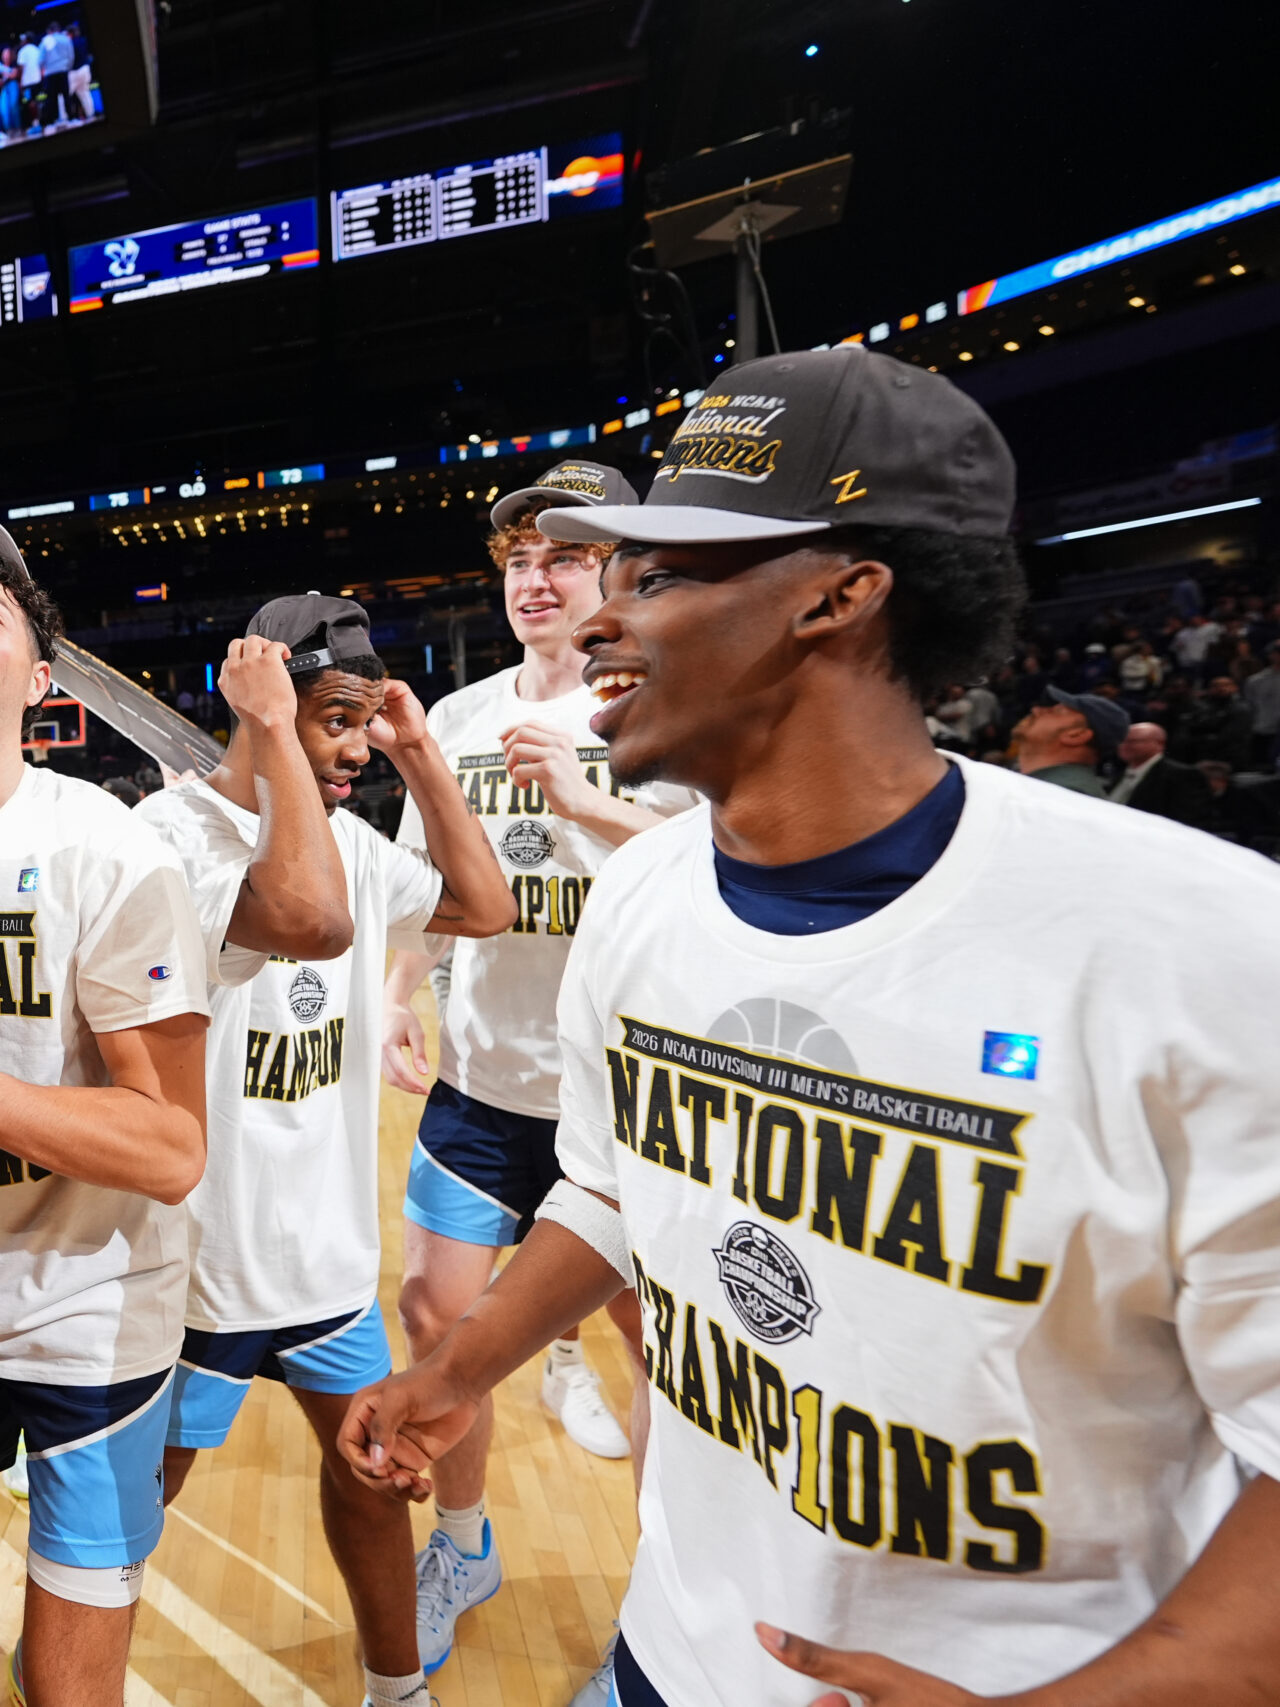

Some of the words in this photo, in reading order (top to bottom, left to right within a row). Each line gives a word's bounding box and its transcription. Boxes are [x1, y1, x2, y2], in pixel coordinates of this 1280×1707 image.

[631, 1027, 658, 1052] 2026
[662, 1038, 698, 1063] NCAA
[701, 1048, 763, 1084] DIVISION
[766, 1067, 788, 1087] III
[790, 1074, 850, 1106] MEN'S
[852, 1090, 998, 1142] BASKETBALL
[606, 1047, 1051, 1305] NATIONAL
[724, 1260, 807, 1316] CHAMPIONSHIP
[729, 1247, 795, 1297] BASKETBALL
